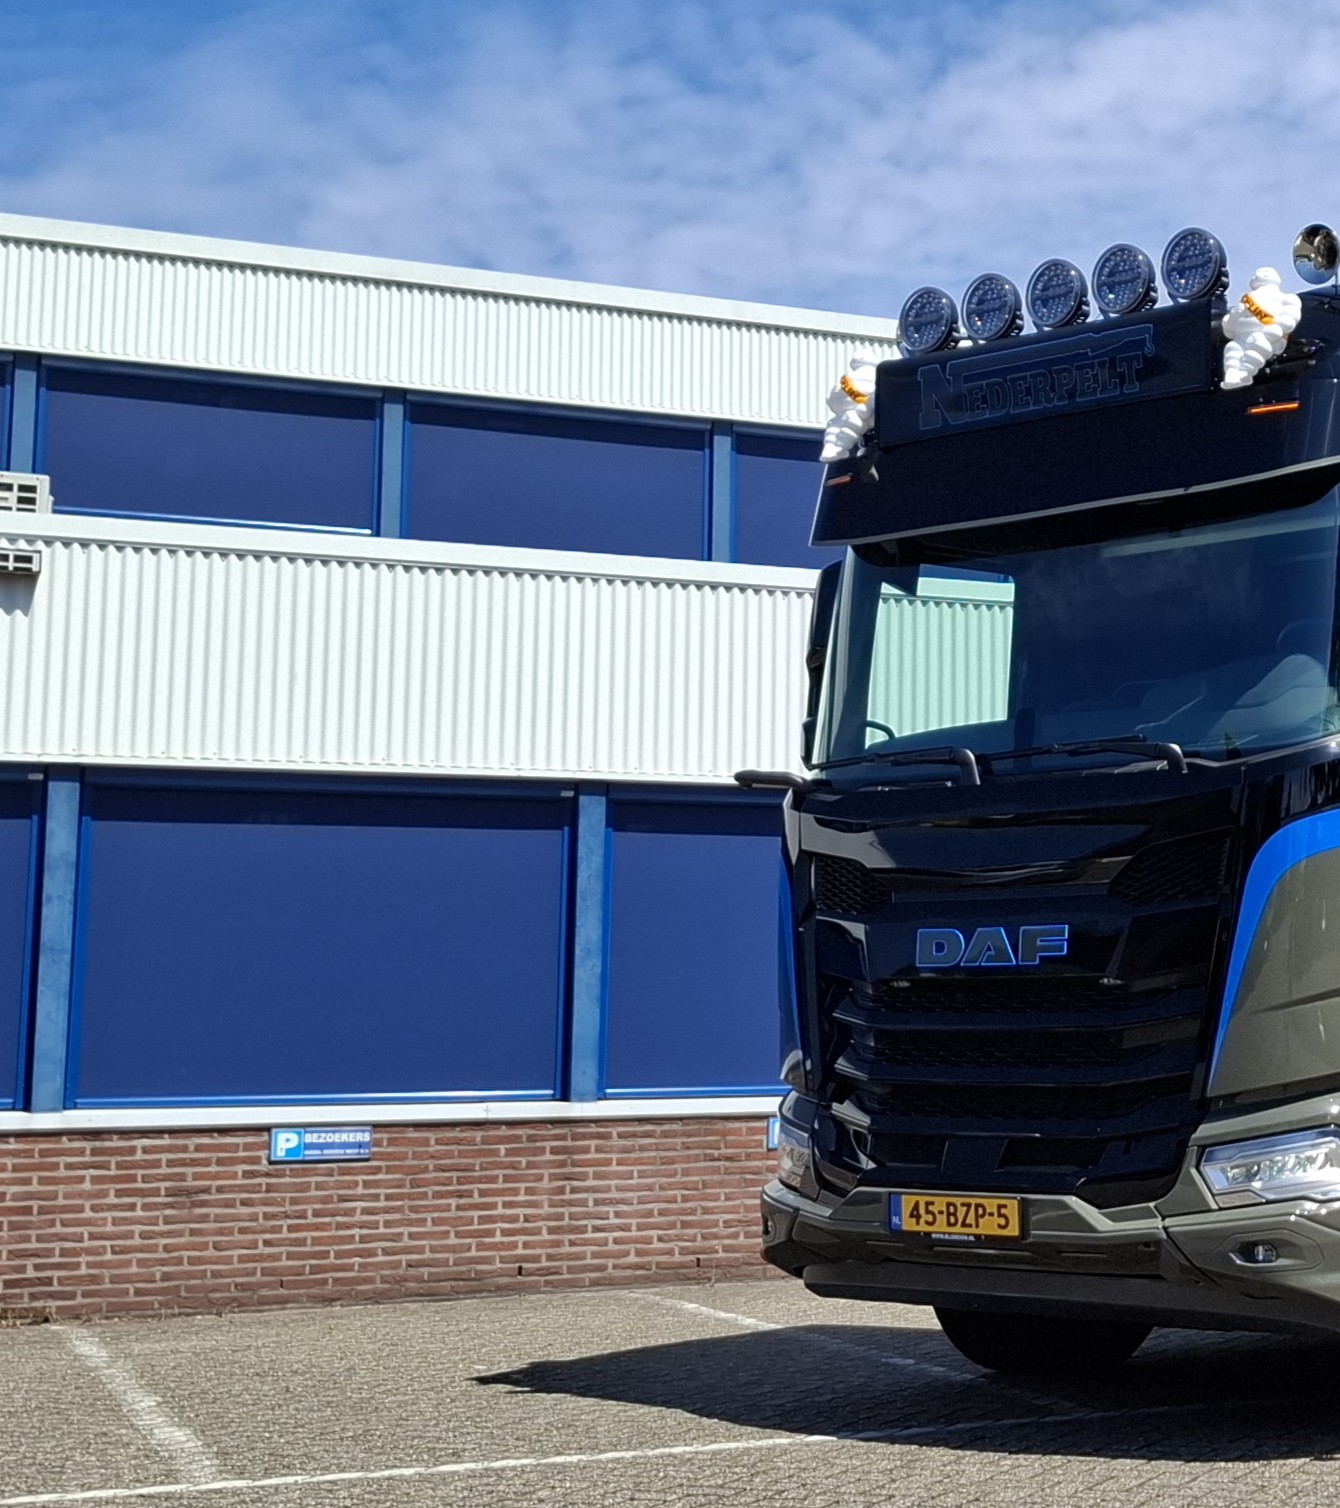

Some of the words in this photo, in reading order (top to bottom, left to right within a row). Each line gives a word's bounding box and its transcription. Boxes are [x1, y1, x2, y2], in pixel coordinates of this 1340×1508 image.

[917, 351, 1144, 431] NEDERPELT
[916, 925, 1069, 967] DAF
[304, 1132, 371, 1143] BEZOEKERS
[908, 1200, 1010, 1230] 45-BZP-5
